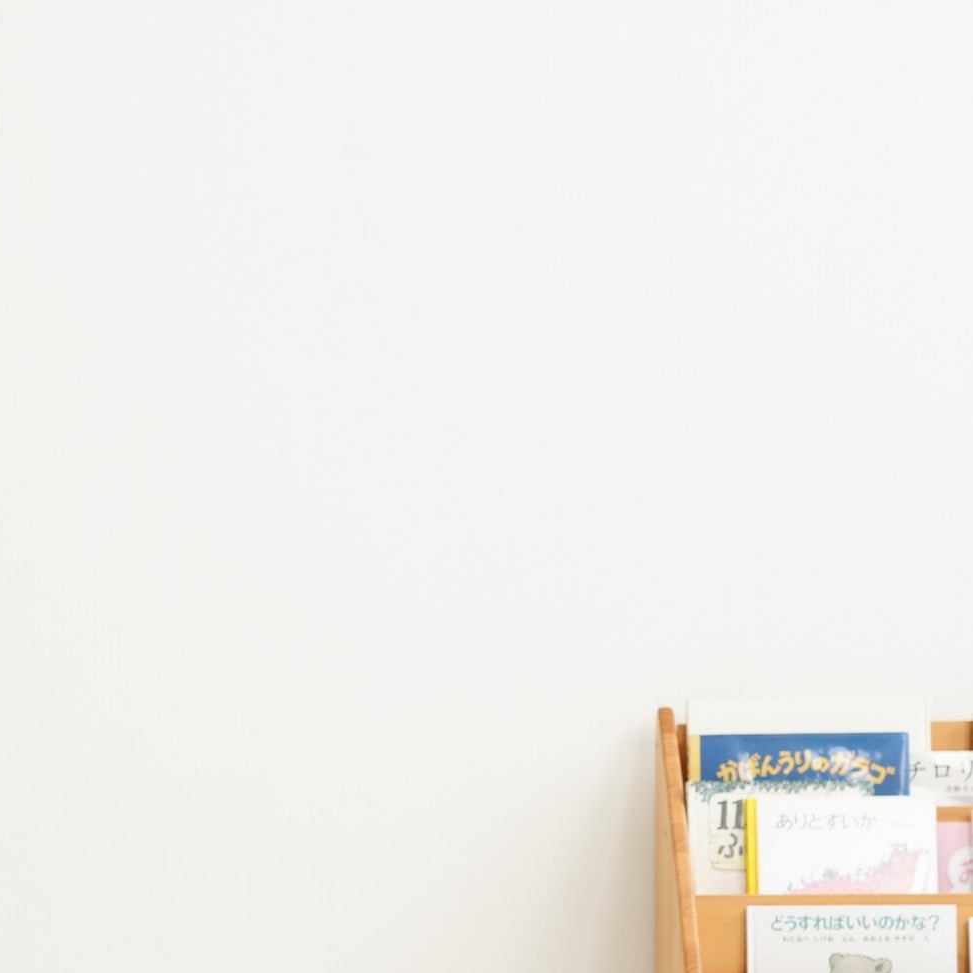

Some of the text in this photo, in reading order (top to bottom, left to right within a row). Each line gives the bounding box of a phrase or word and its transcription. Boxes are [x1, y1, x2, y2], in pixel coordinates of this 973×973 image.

[716, 749, 896, 785] かばんうりのガラゴ
[775, 813, 877, 831] ありとすいか
[770, 914, 940, 932] どうすればいいのかな？
